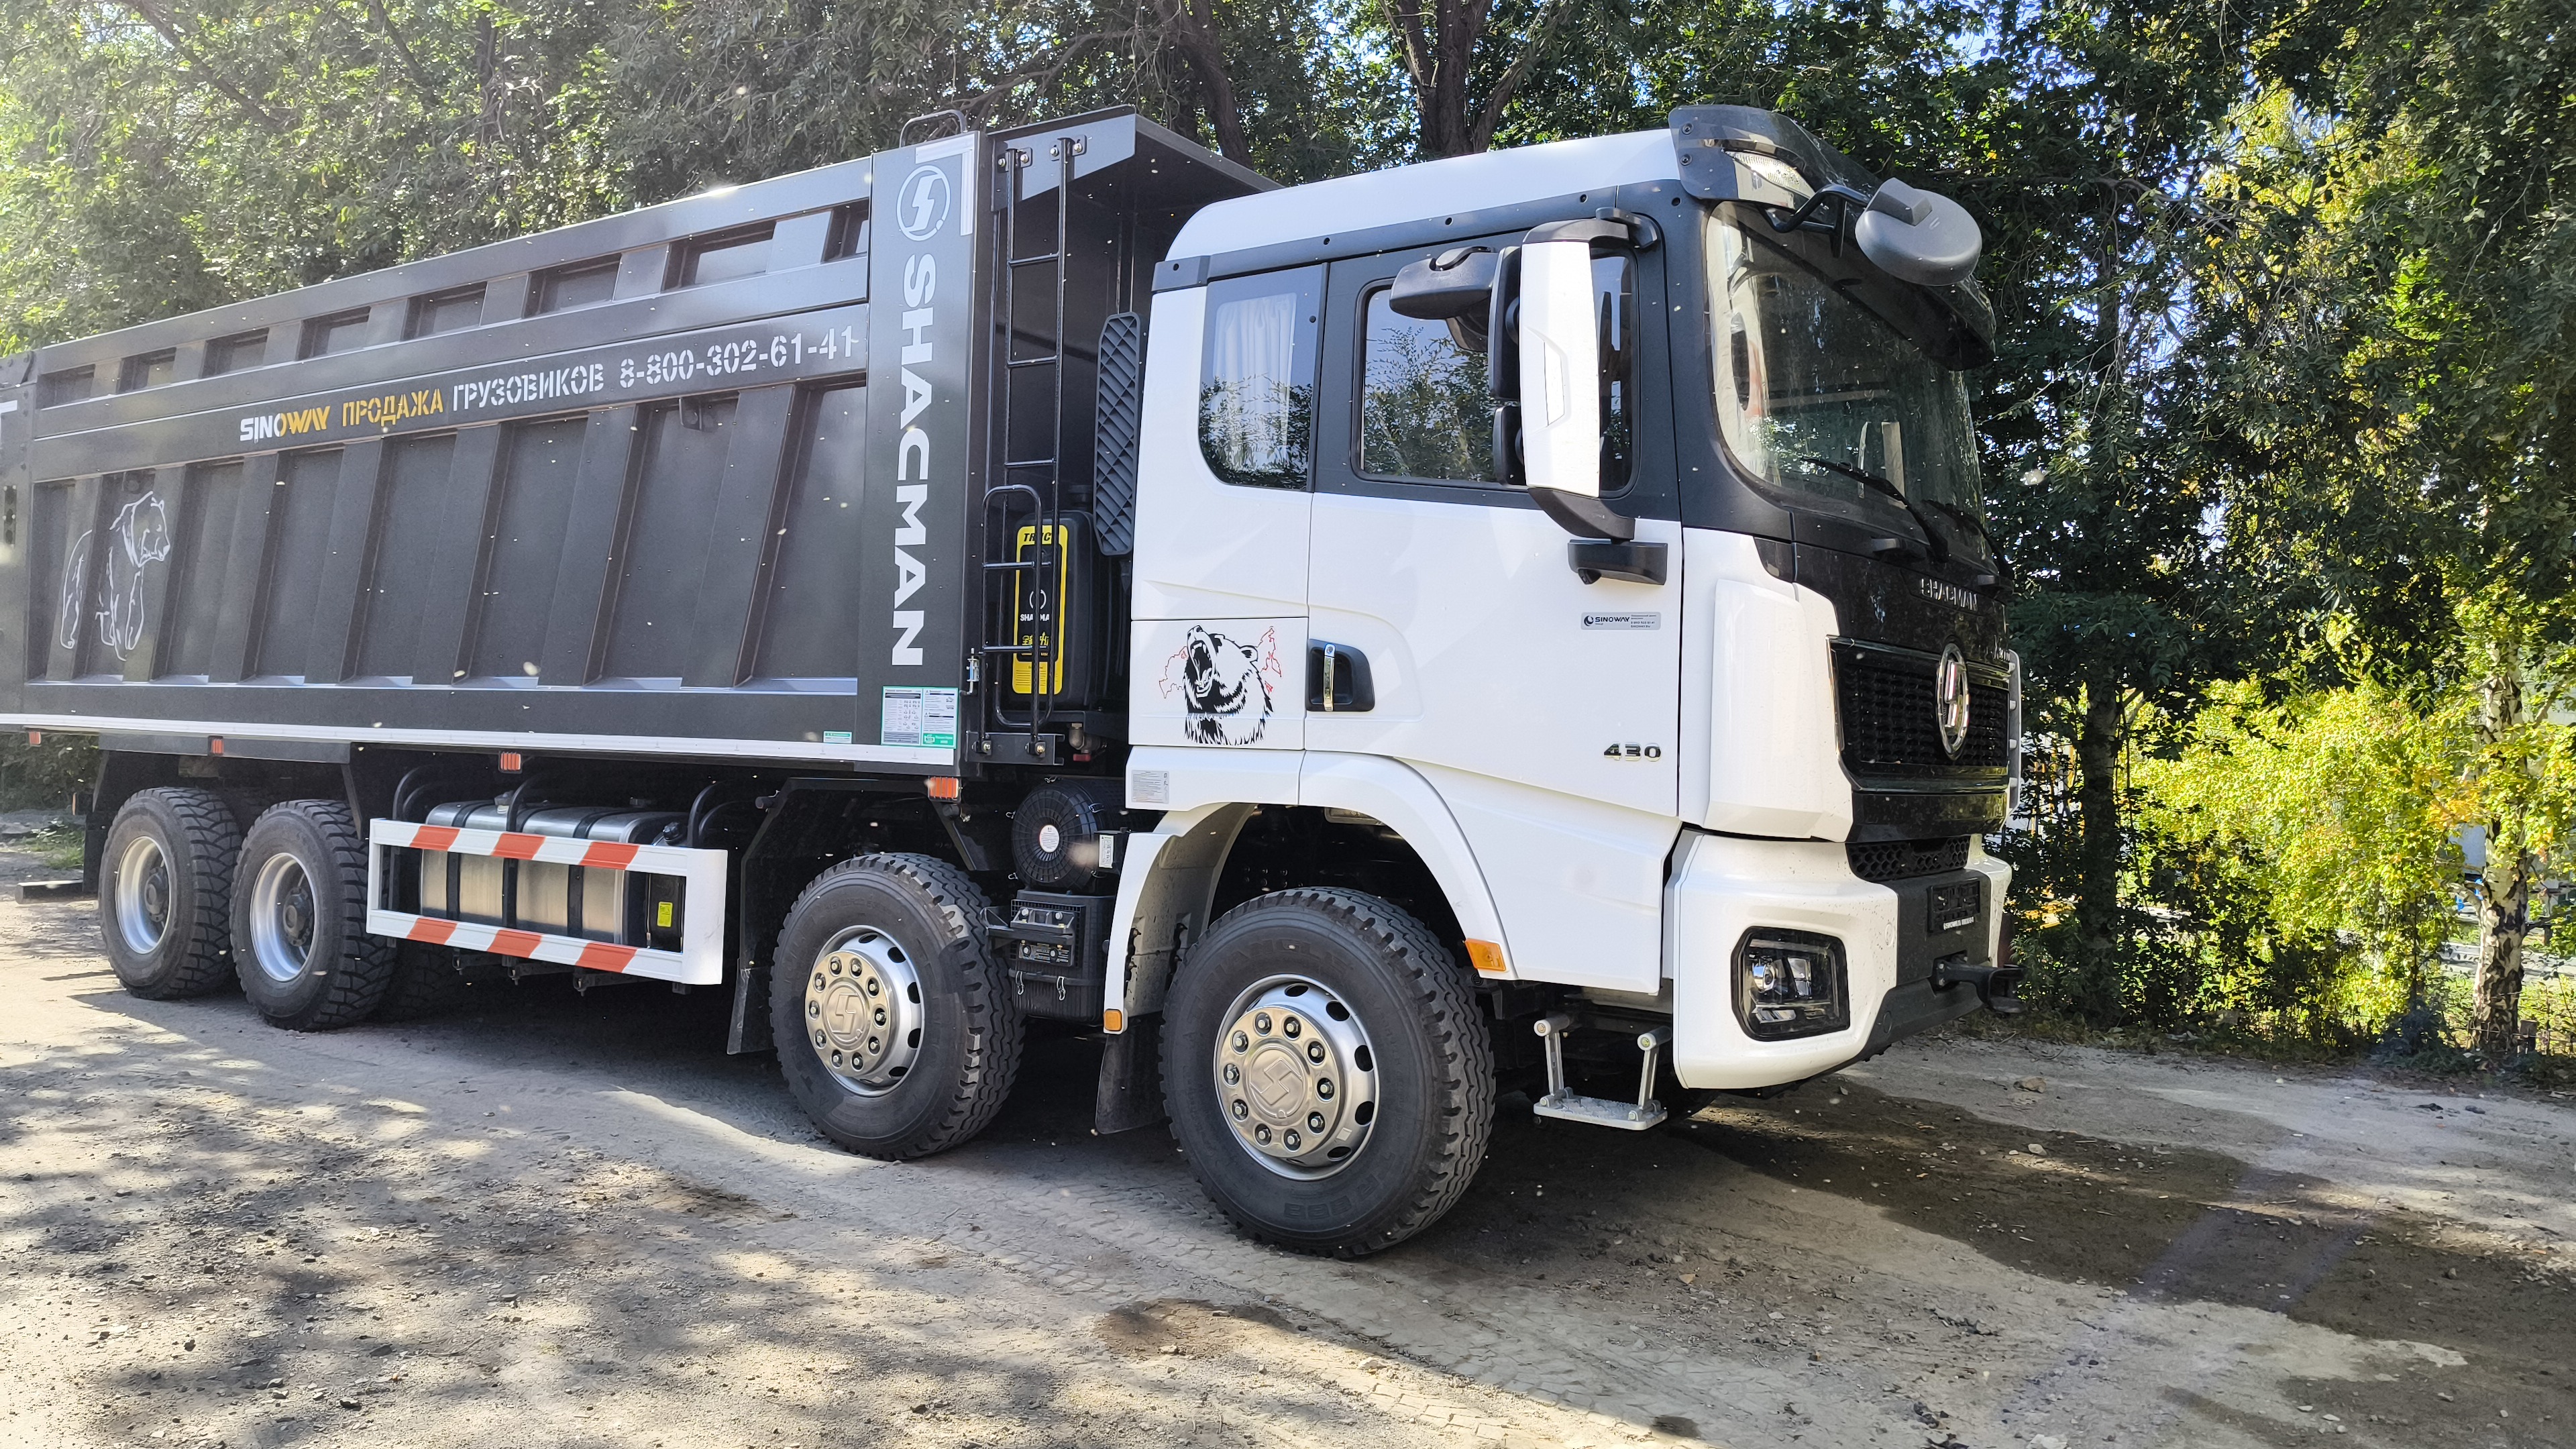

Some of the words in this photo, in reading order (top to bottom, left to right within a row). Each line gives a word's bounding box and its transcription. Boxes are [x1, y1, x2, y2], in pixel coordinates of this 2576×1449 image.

[239, 406, 330, 442] SINOWAY
[342, 388, 443, 426] ПРОДАЖА
[453, 363, 604, 411] ГРУЗОВИКОВ
[619, 325, 852, 388] 8-800-302-61-41
[892, 254, 937, 666] SHACMAN
[1603, 742, 1662, 762] 430
